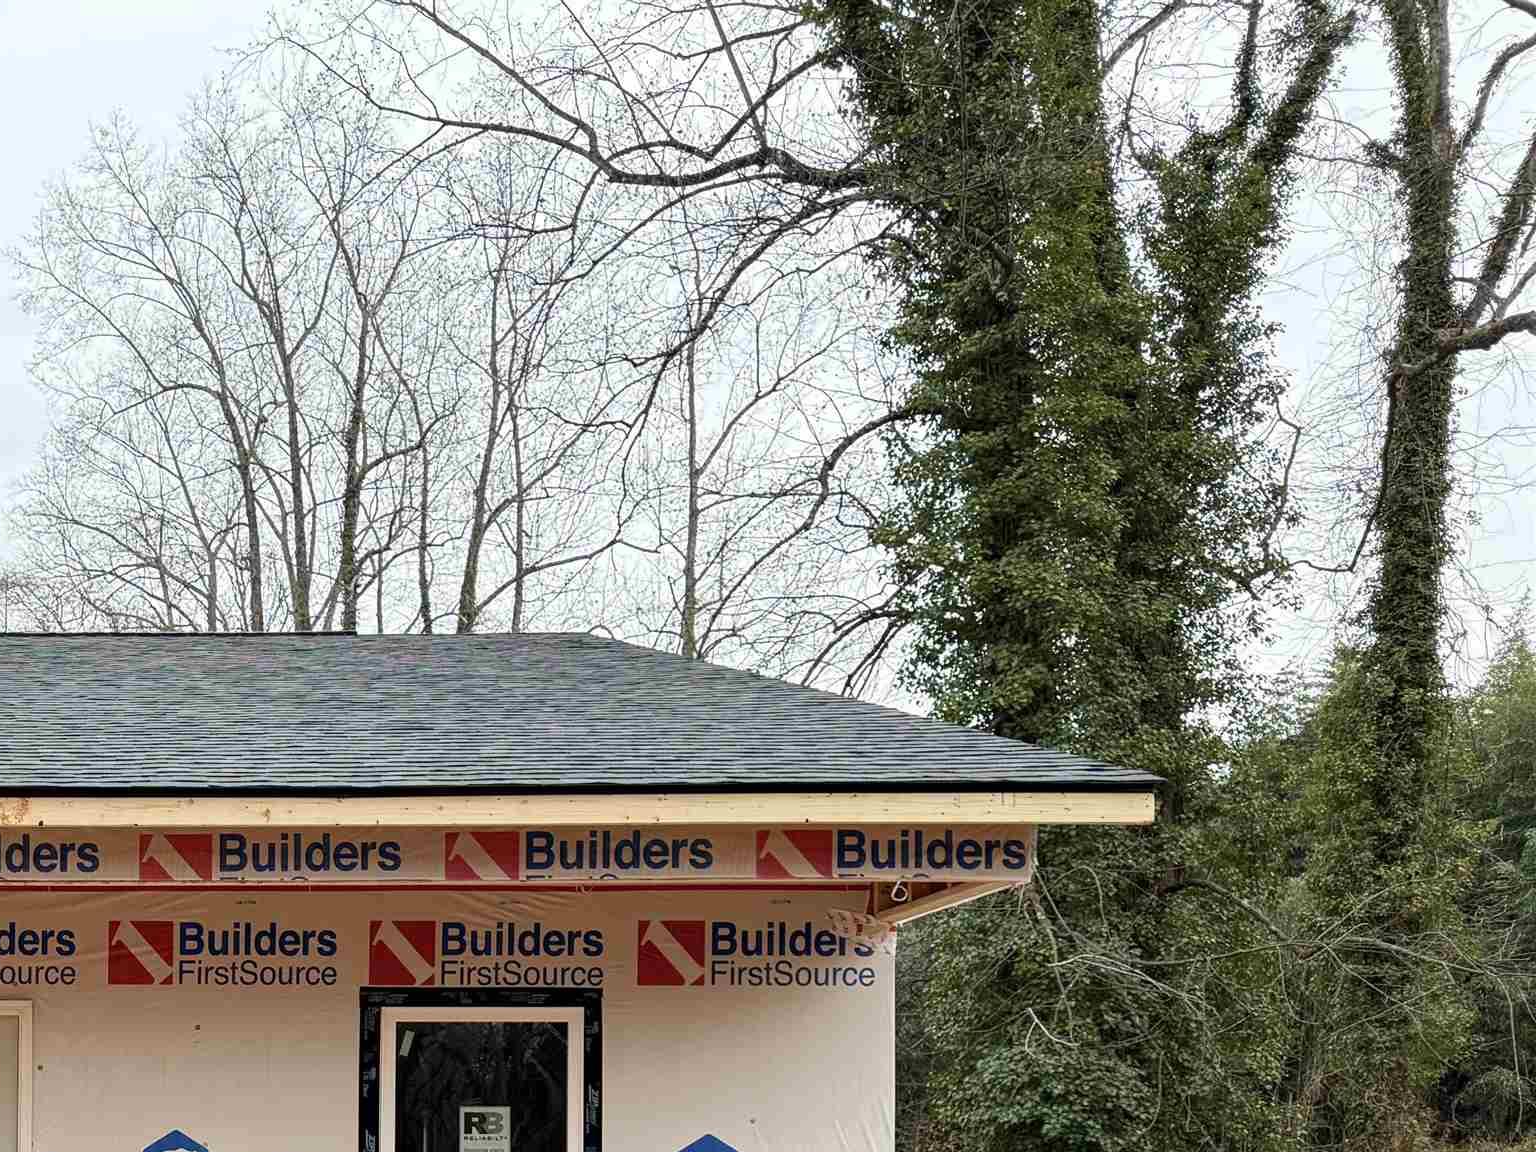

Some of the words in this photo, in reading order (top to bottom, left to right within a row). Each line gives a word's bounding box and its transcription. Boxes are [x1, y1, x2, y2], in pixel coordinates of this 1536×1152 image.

[218, 833, 402, 872] Builders
[526, 831, 714, 870] Builders
[836, 830, 1026, 869] Builders
[179, 922, 337, 957] Builders
[441, 922, 604, 957] Builders
[178, 960, 337, 986] FirstSource
[441, 960, 604, 986] FirstSource
[711, 960, 876, 987] FirstSource
